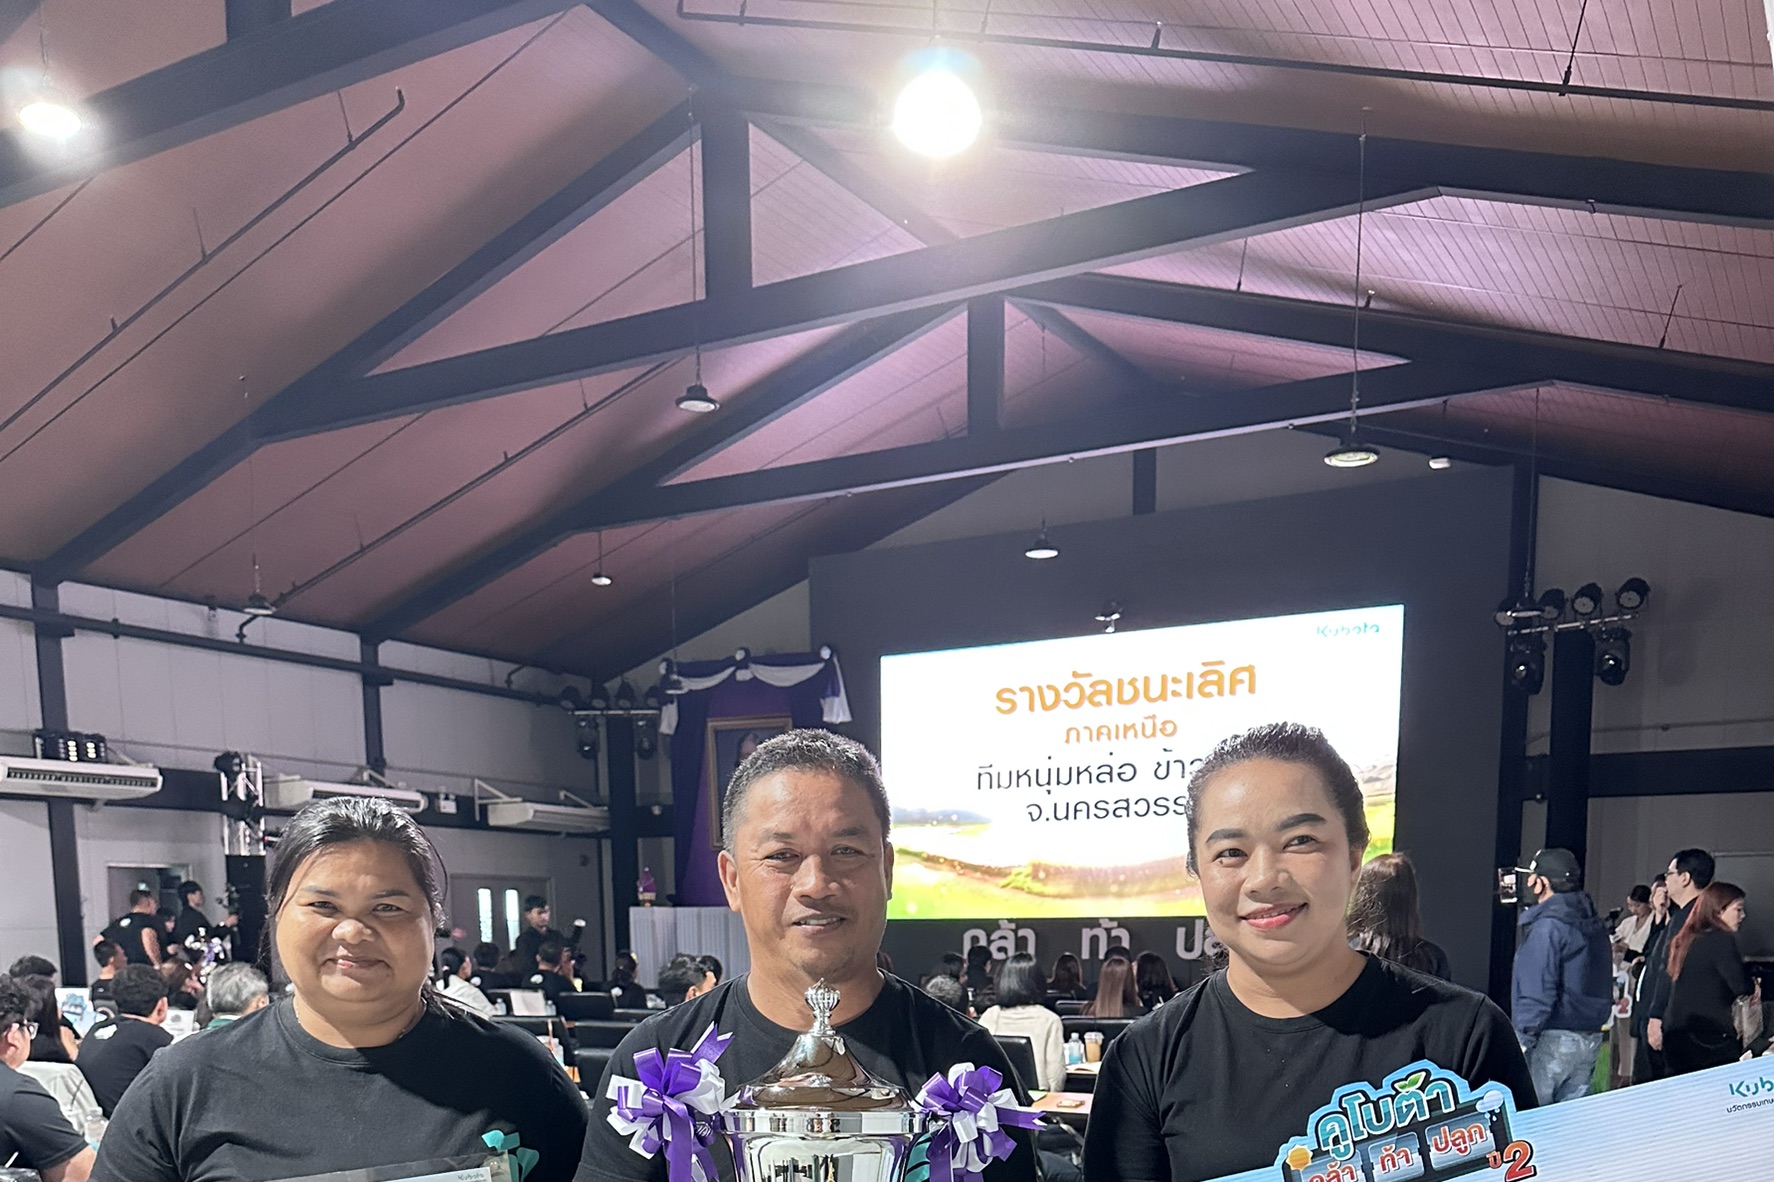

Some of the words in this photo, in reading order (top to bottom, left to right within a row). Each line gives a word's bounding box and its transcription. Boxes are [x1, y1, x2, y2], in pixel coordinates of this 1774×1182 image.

[1316, 621, 1380, 638] Kubota
[995, 659, 1257, 715] รางวัลชนะเลิศ
[1064, 714, 1178, 744] ภาคเหนือ
[976, 751, 1138, 796] ทีมหนุ่มหล่อ
[1318, 1071, 1453, 1159] คูโบต้า
[1379, 1143, 1412, 1173] ท้า
[1432, 1122, 1487, 1155] ปลูก
[1502, 1140, 1537, 1182] 2
